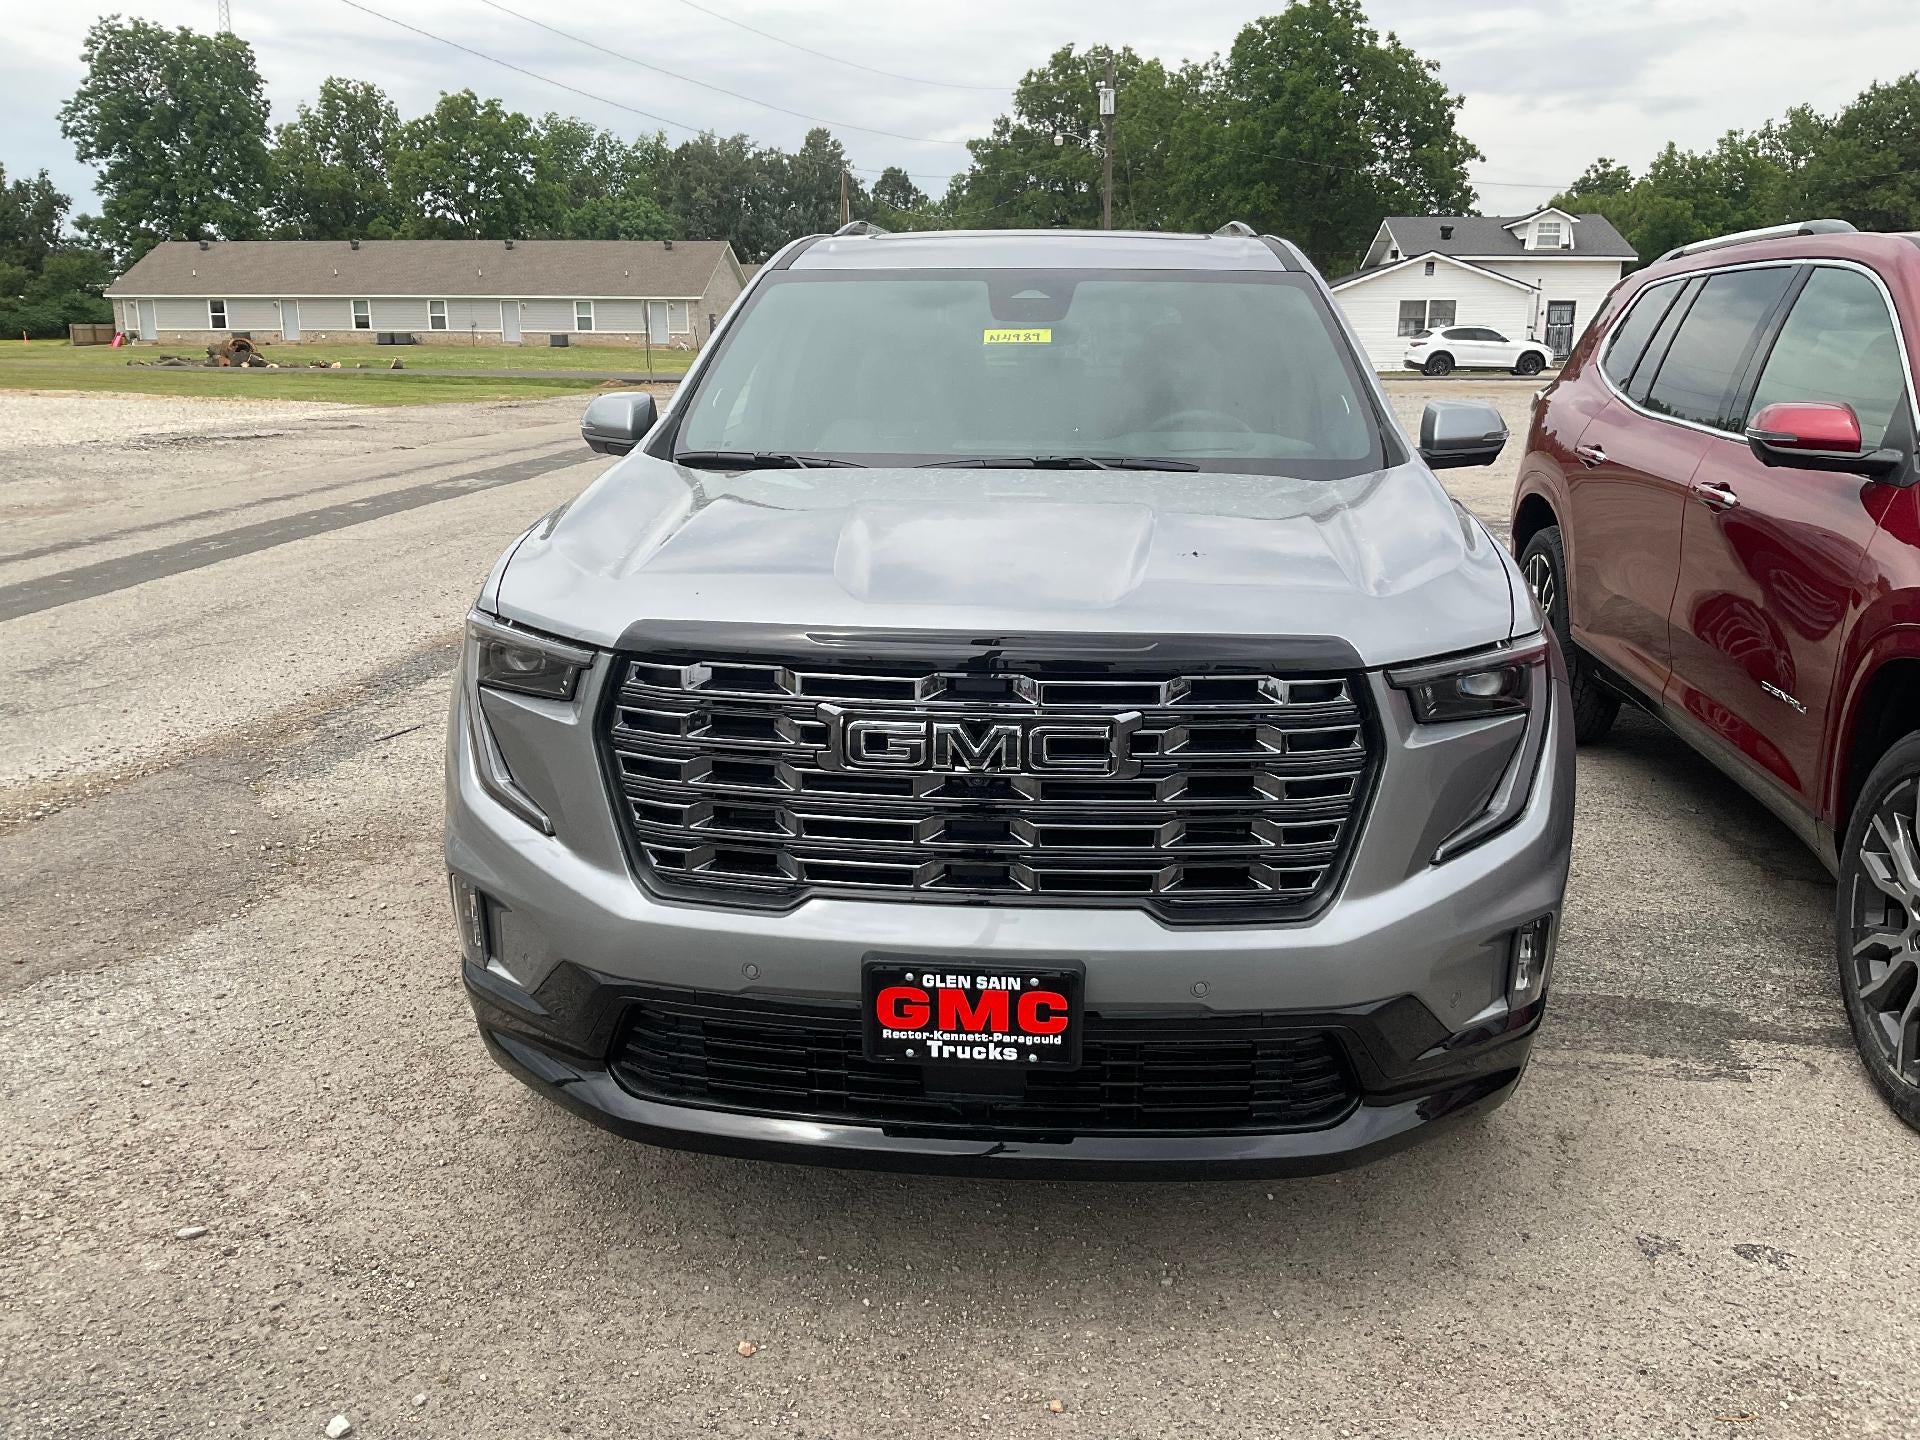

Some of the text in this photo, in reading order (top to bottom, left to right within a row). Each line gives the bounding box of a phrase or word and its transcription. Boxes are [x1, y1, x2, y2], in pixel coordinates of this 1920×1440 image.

[847, 719, 1110, 772] GMC
[922, 974, 1021, 990] GLEN SAIN
[876, 986, 1068, 1034] GMC
[926, 1040, 1018, 1061] Trucks
